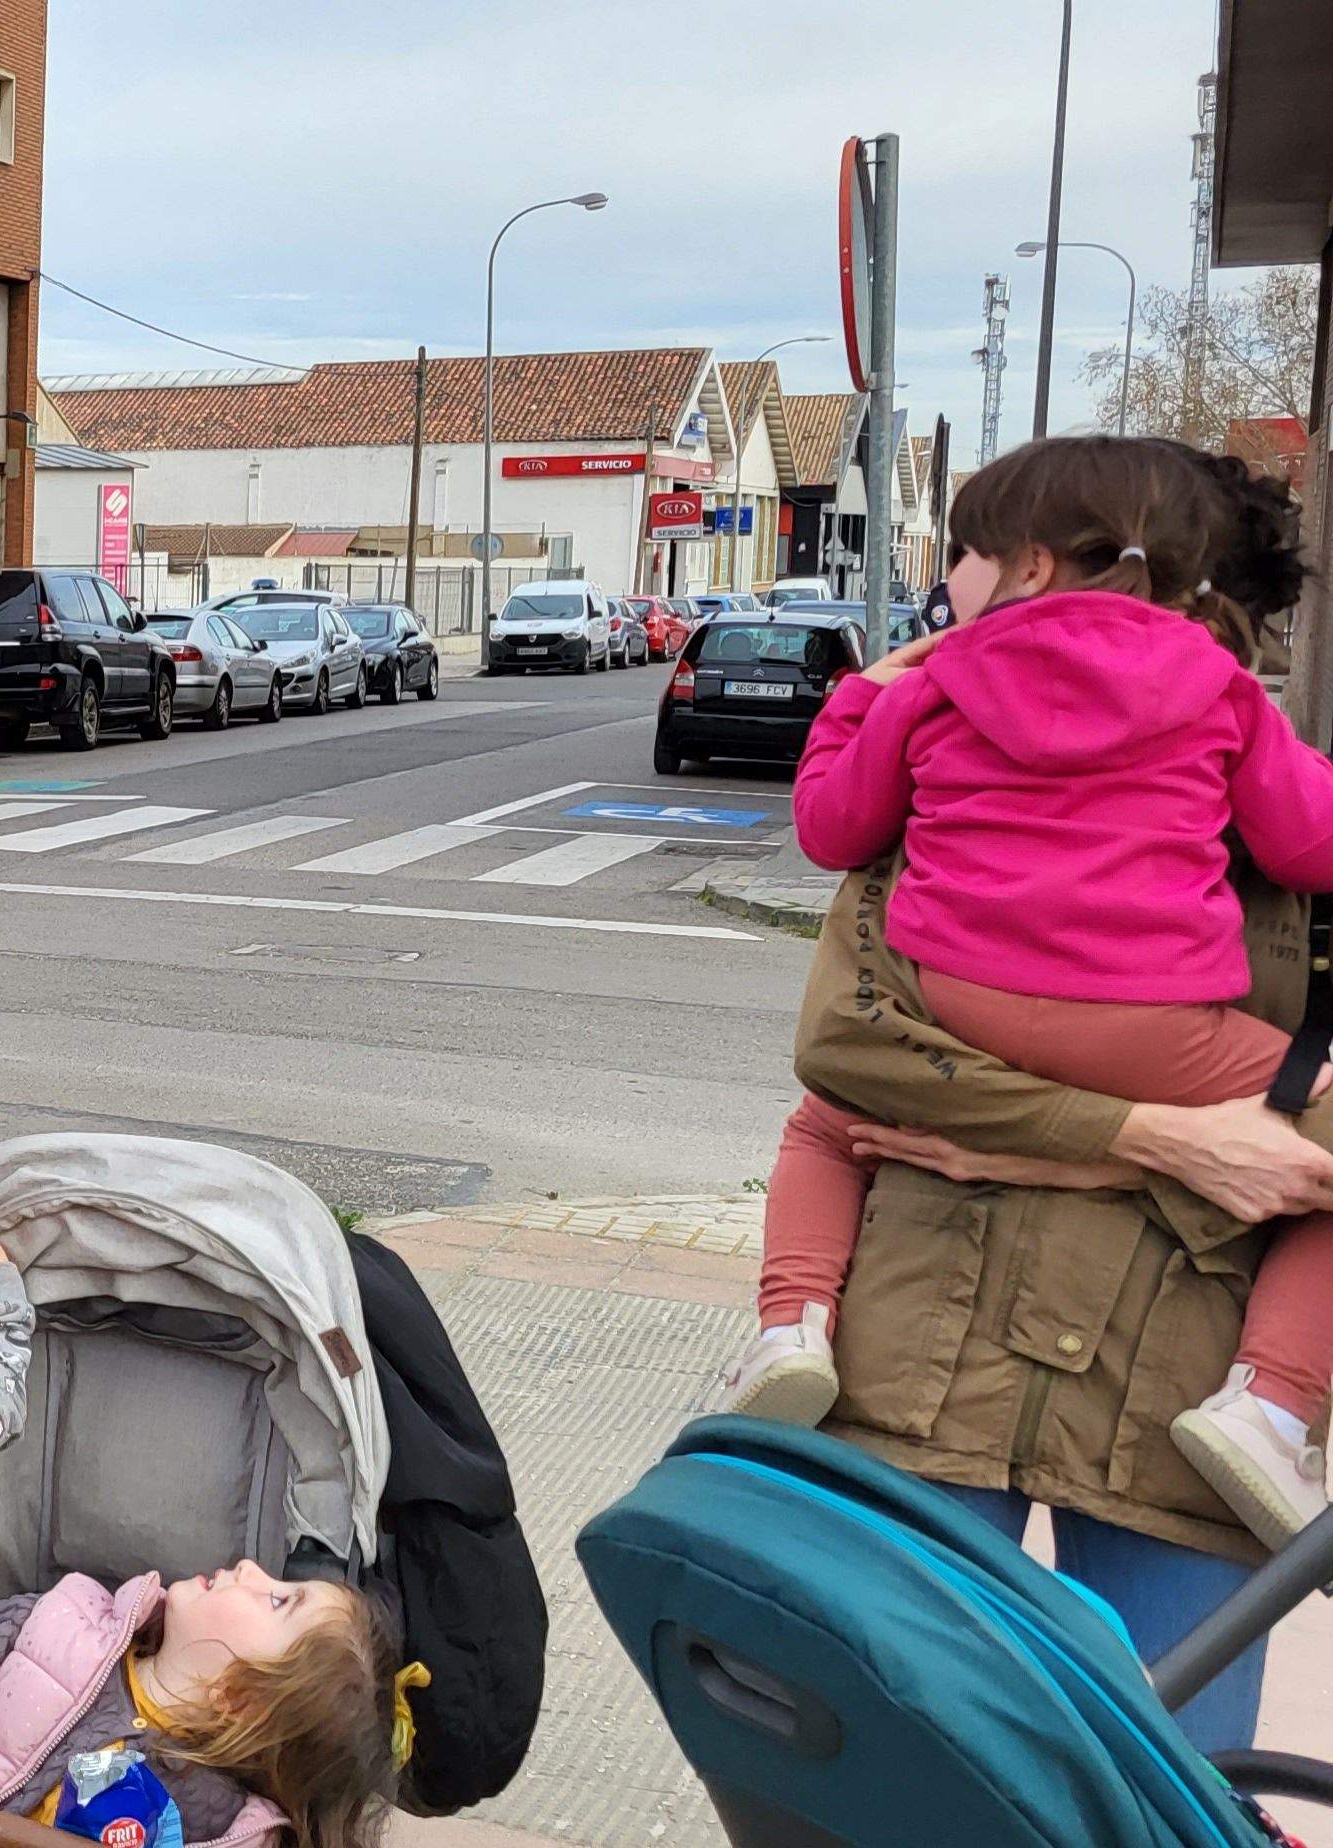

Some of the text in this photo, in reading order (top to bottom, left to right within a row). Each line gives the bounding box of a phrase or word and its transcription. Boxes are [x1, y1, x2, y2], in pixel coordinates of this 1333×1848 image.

[581, 460, 632, 470] SERVICIO
[656, 529, 697, 537] SERVICIO
[733, 683, 789, 695] 3696 FCV
[107, 1823, 138, 1845] FRIT
